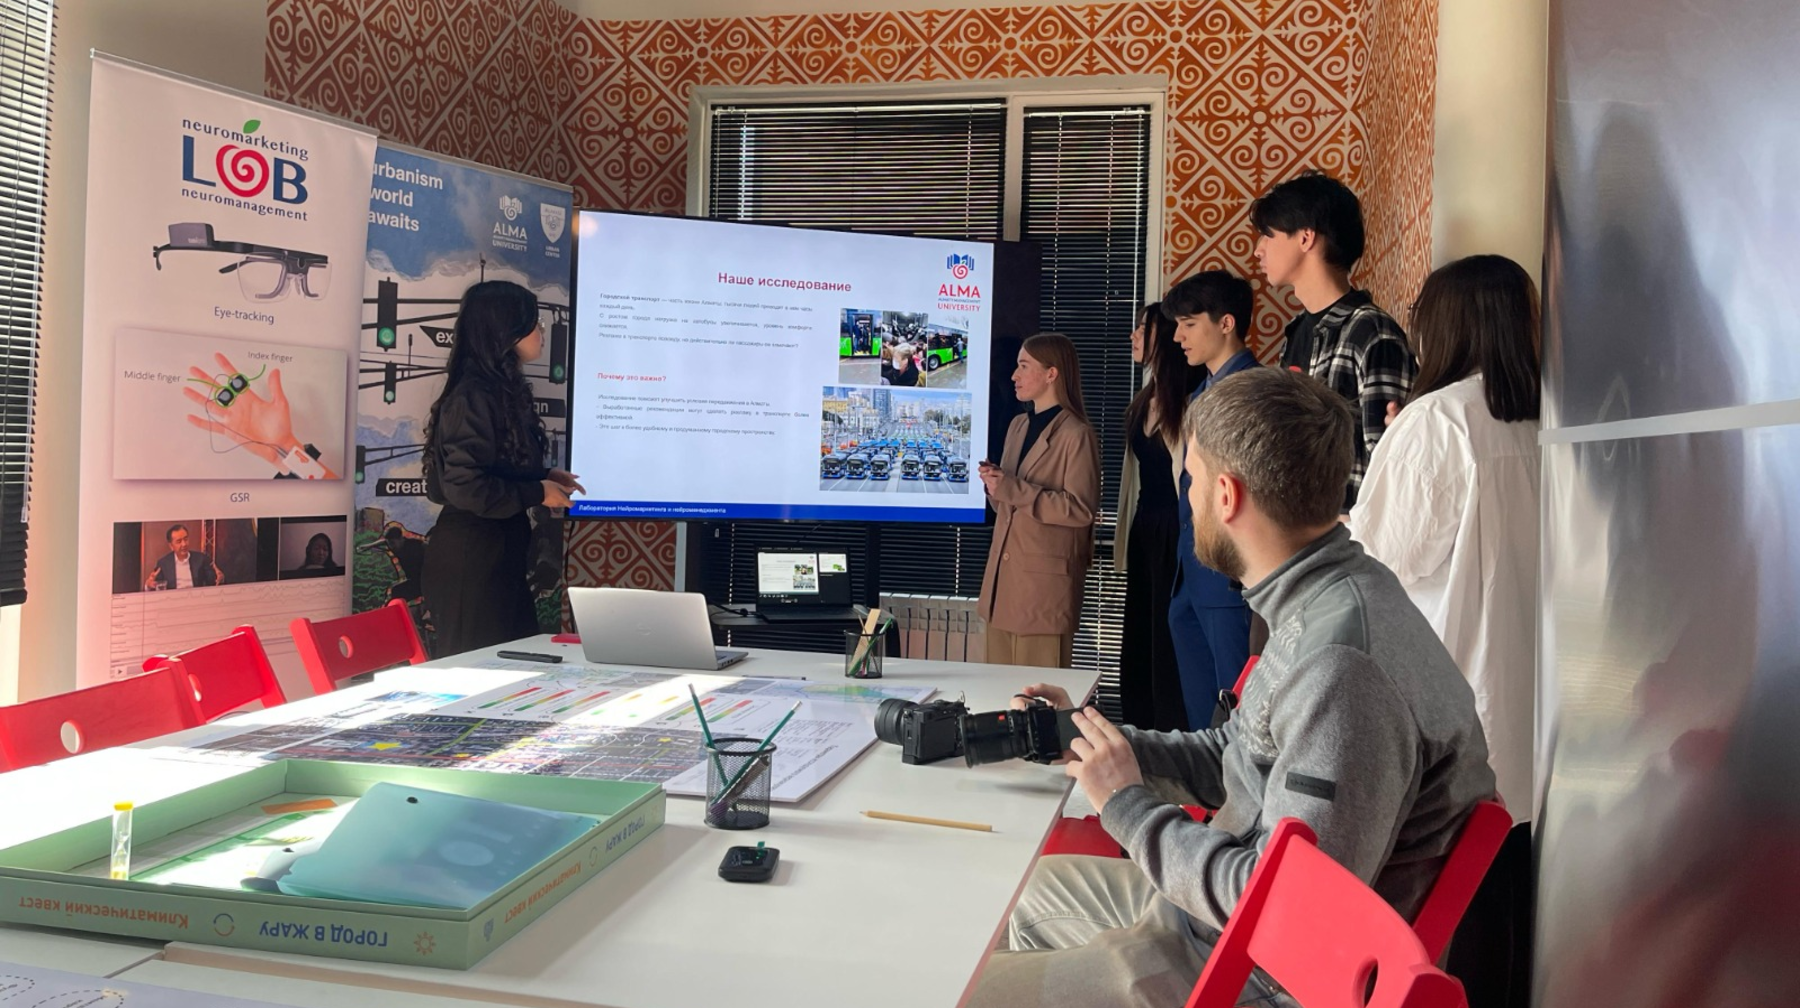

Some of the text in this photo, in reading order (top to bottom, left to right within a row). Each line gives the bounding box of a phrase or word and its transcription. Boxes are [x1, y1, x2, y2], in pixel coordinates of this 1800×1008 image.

[182, 119, 309, 161] neuromarketing
[181, 188, 307, 221] neuromanagement
[370, 187, 413, 207] world
[368, 210, 419, 232] awaits
[493, 221, 528, 240] ALMA
[492, 239, 527, 252] UNIVERSITY
[718, 272, 852, 292] Наше исследование
[938, 283, 981, 299] ALMA
[937, 302, 981, 312] UNIVERSITY
[214, 306, 275, 325] Eye-tracking
[436, 330, 455, 344] ex
[248, 351, 293, 364] Index finger
[124, 370, 181, 384] Middle finger
[598, 373, 624, 381] Почему
[533, 402, 549, 415] gn
[385, 479, 428, 494] creat
[230, 492, 250, 503] GSR
[578, 504, 617, 512] Лаборатория
[617, 505, 667, 513] Нейромаркетинга
[19, 896, 189, 929] Климатический квест
[259, 920, 389, 948] ГОРОД В ЖАРУ
